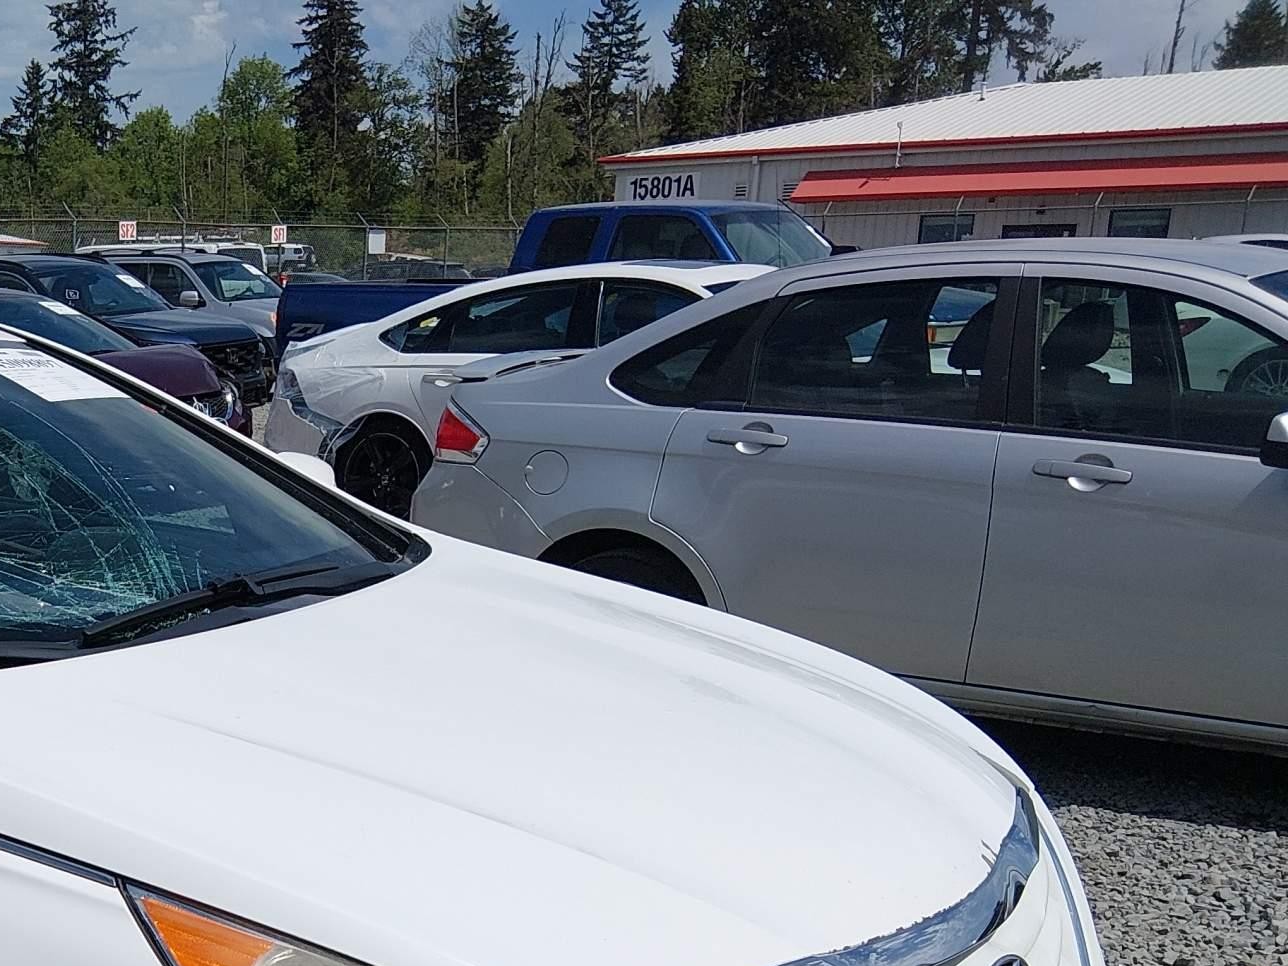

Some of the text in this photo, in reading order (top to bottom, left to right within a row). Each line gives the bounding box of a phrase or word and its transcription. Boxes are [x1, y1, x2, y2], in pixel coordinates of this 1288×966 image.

[630, 174, 695, 200] 15801A
[120, 223, 135, 239] SF2
[273, 227, 285, 242] SF1
